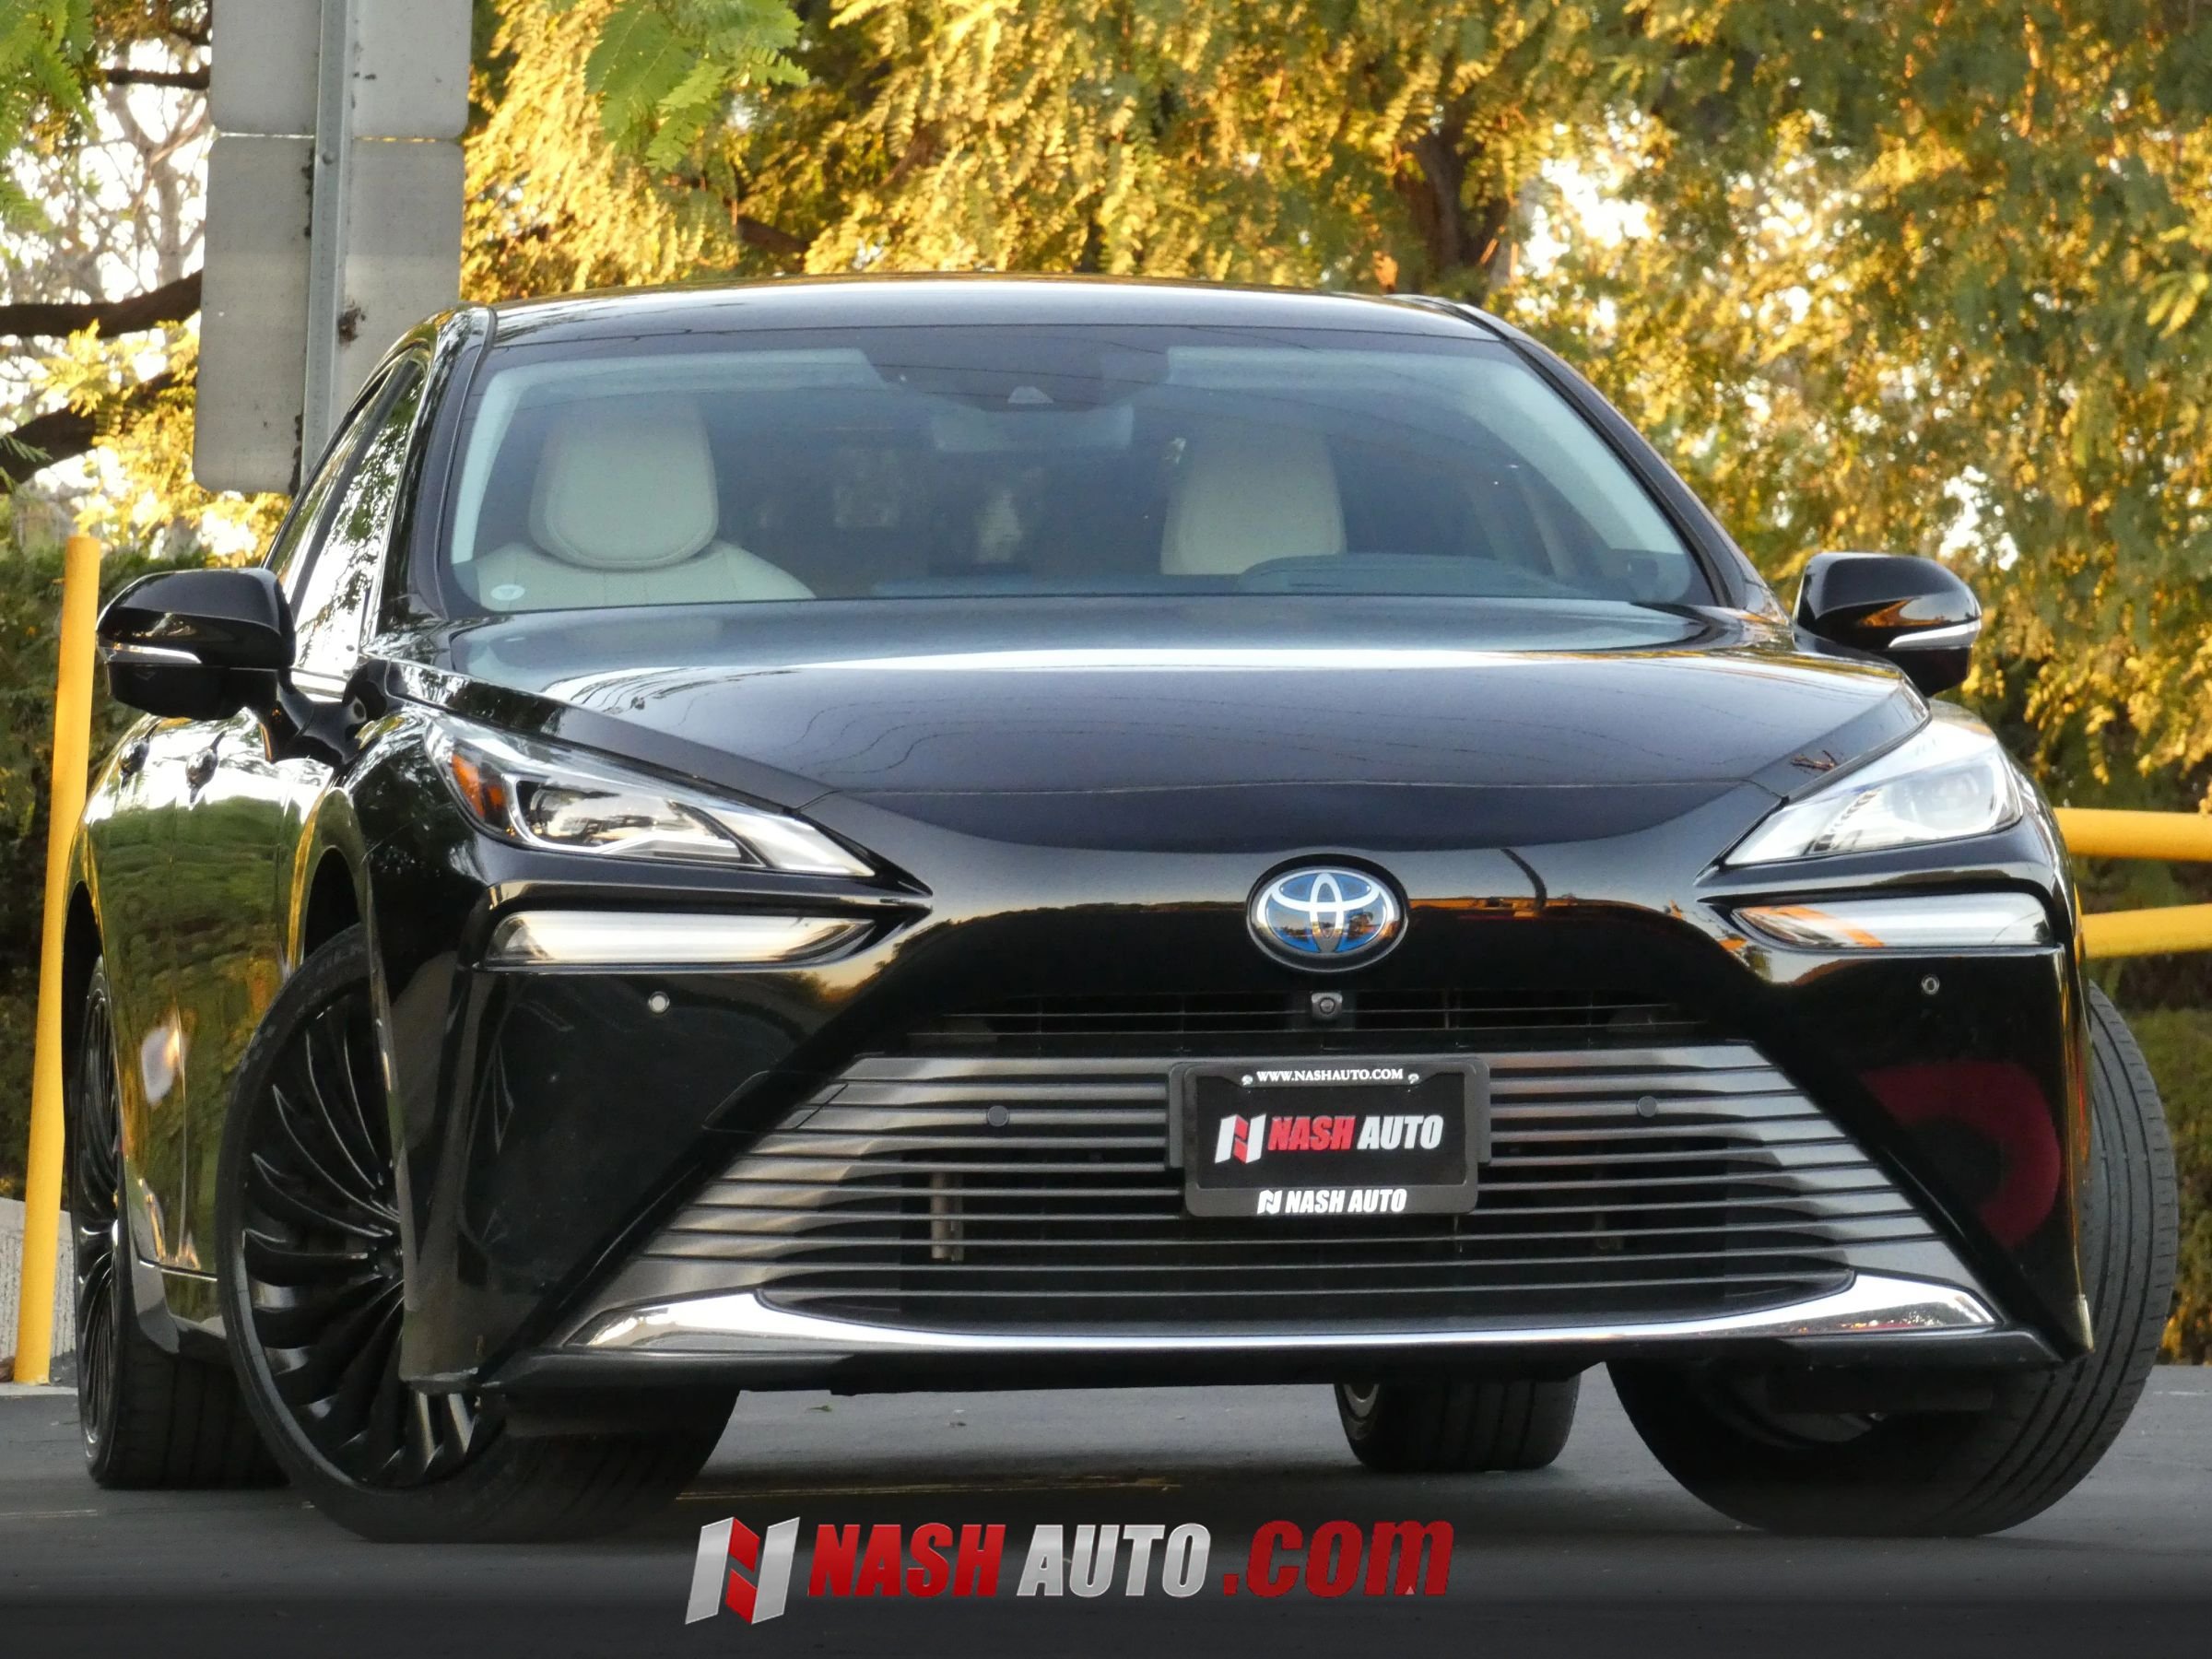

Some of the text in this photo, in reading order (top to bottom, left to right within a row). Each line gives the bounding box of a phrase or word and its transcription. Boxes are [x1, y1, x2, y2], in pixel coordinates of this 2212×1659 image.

[1256, 1068, 1404, 1083] WWW.NASHAUTO.COM
[1267, 1115, 1356, 1150] NASH
[1358, 1115, 1444, 1149] AUTO
[1285, 1190, 1347, 1214] NASH
[1347, 1189, 1407, 1213] AUTO
